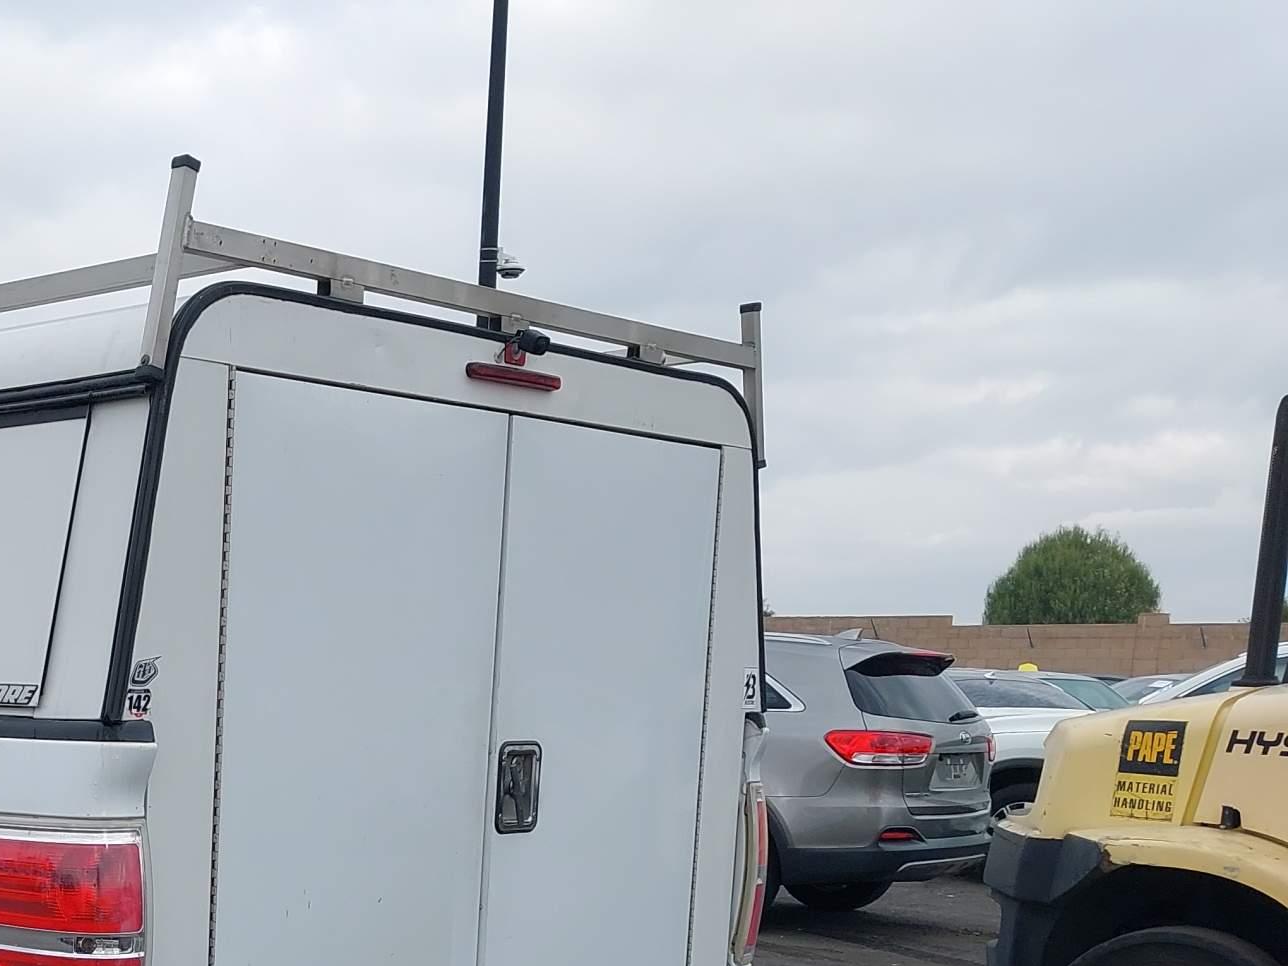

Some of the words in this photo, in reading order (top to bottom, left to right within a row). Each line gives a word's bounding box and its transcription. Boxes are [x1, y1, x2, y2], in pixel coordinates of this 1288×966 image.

[127, 694, 151, 713] 142
[1115, 780, 1174, 797] MATERIAL
[1113, 797, 1173, 813] HANDLING
